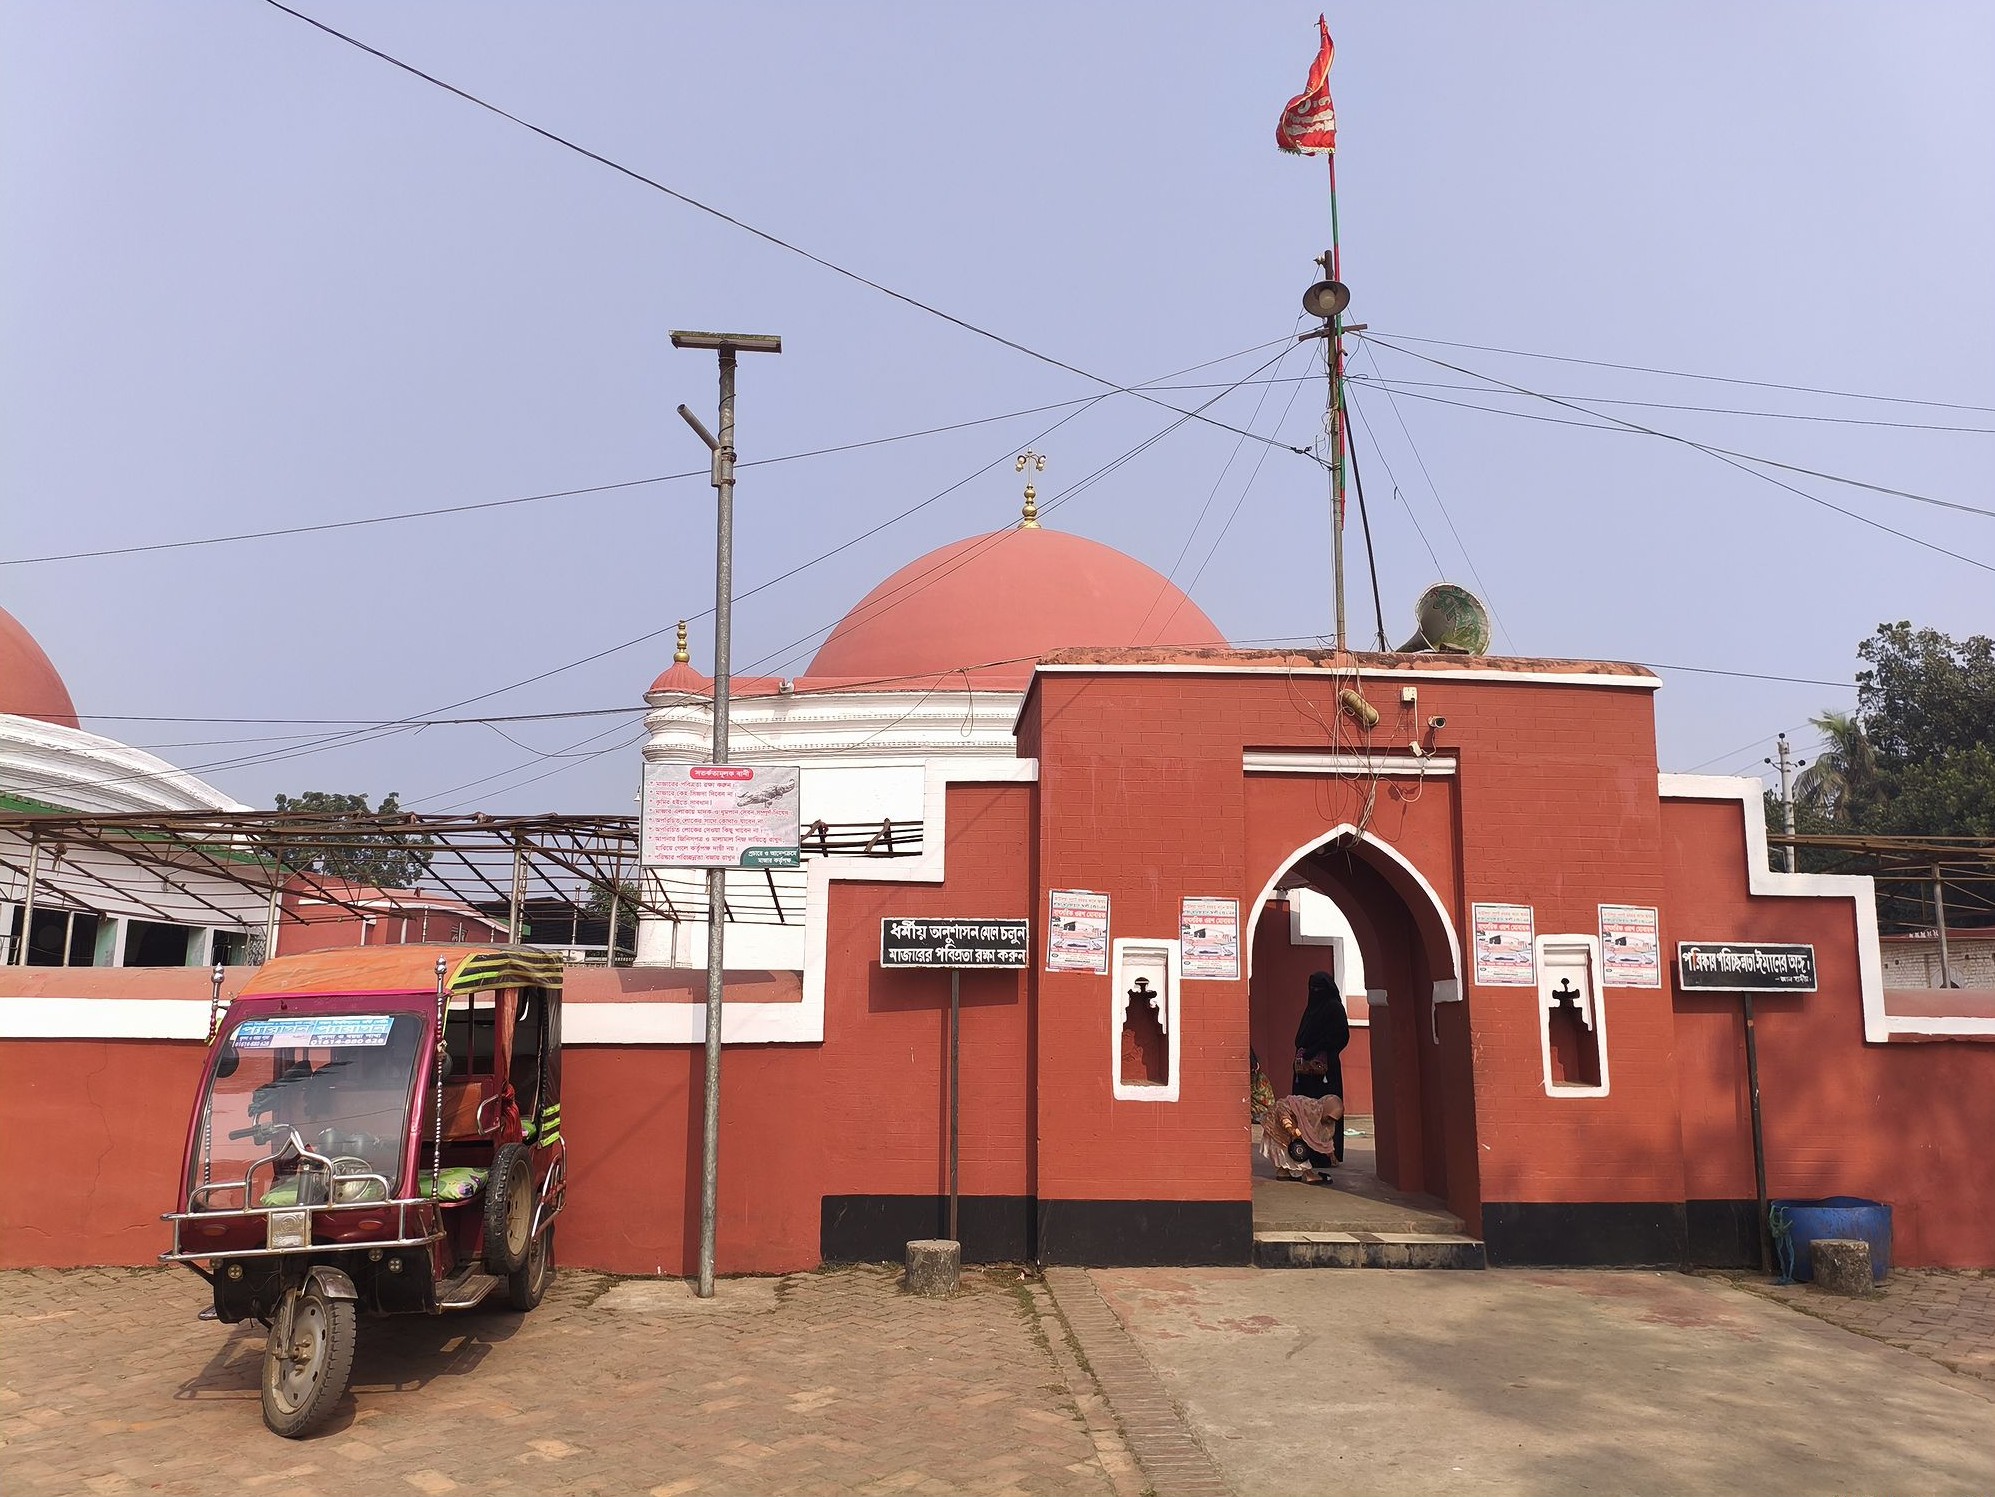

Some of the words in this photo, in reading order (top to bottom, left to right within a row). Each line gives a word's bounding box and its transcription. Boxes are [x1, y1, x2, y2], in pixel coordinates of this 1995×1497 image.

[889, 920, 927, 940] ধর্মীয়
[929, 924, 979, 944] অনুশাসন
[981, 926, 999, 940] মেনে
[1000, 926, 1026, 944] চলুন
[888, 948, 933, 963] মাজারের
[935, 943, 974, 963] পবিত্রতা
[975, 949, 996, 963] রক্ষা
[997, 949, 1026, 963] করুন
